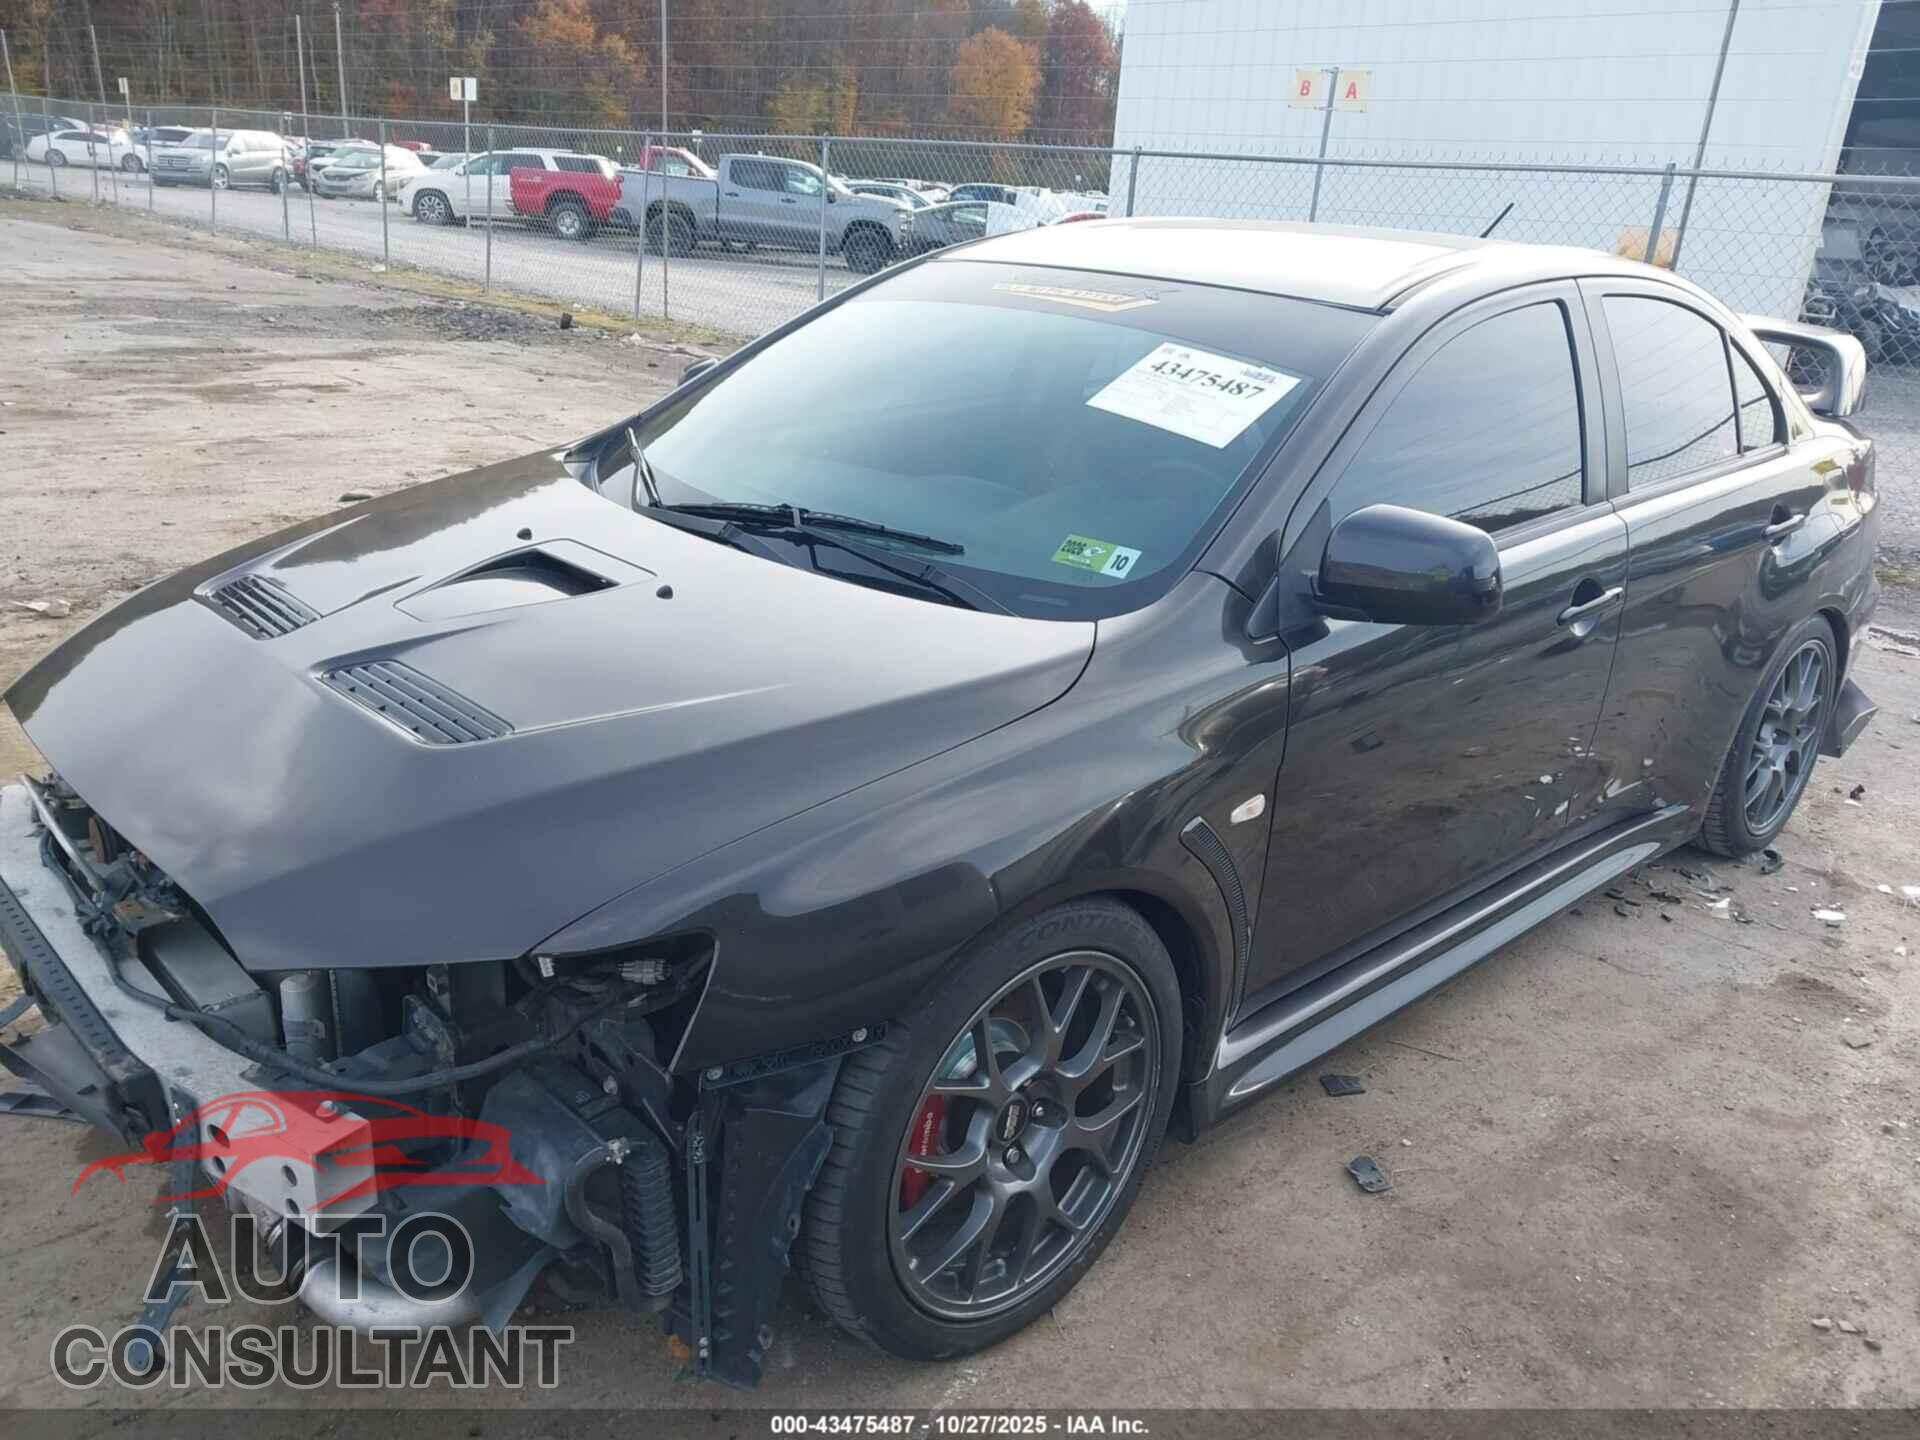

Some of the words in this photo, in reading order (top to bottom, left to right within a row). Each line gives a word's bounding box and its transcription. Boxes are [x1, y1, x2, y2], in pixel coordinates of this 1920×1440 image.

[1300, 80, 1312, 96] B
[1345, 81, 1358, 99] A
[1151, 360, 1265, 399] 43475487
[1110, 554, 1130, 571] 10
